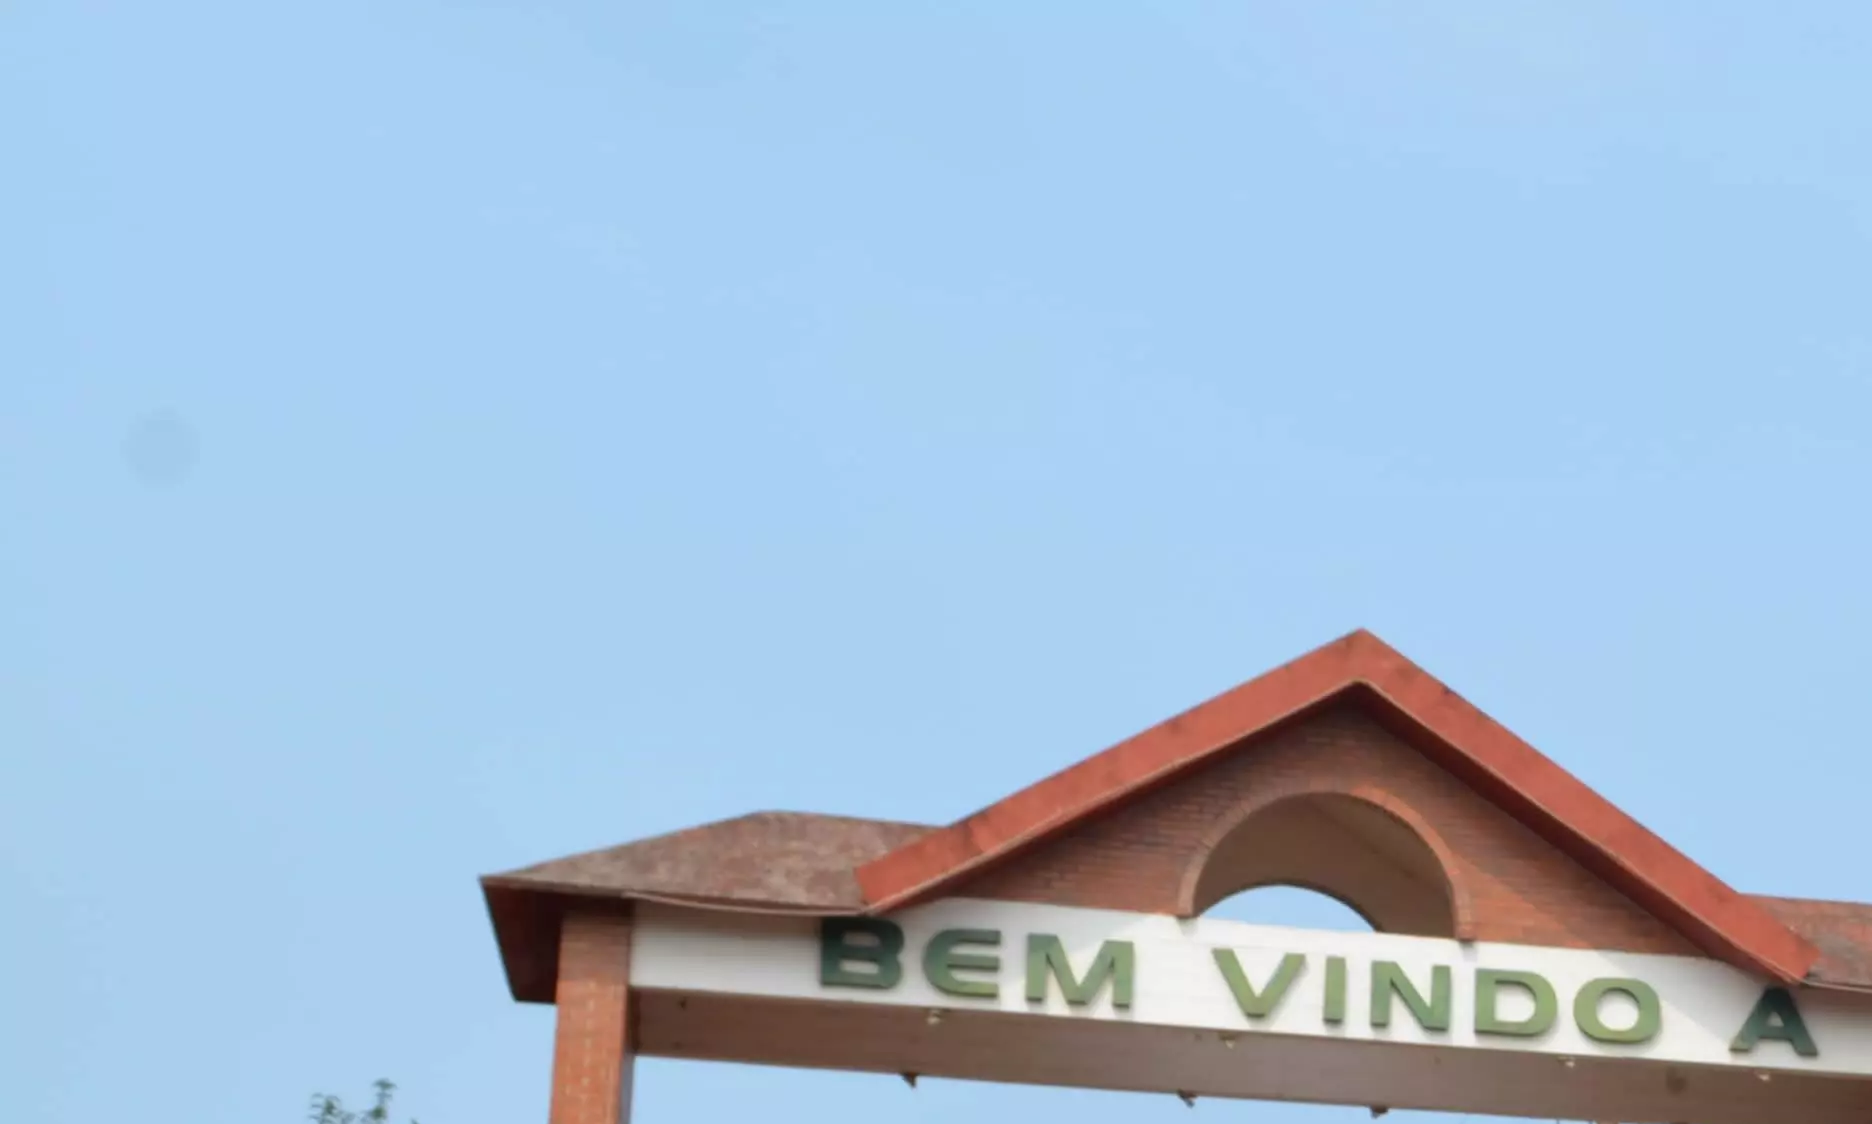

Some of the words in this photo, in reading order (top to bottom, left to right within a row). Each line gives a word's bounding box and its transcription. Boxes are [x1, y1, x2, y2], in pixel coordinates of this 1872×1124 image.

[820, 916, 1134, 1008] BEM
[1211, 947, 1663, 1044] VINDO
[1728, 984, 1819, 1057] A
